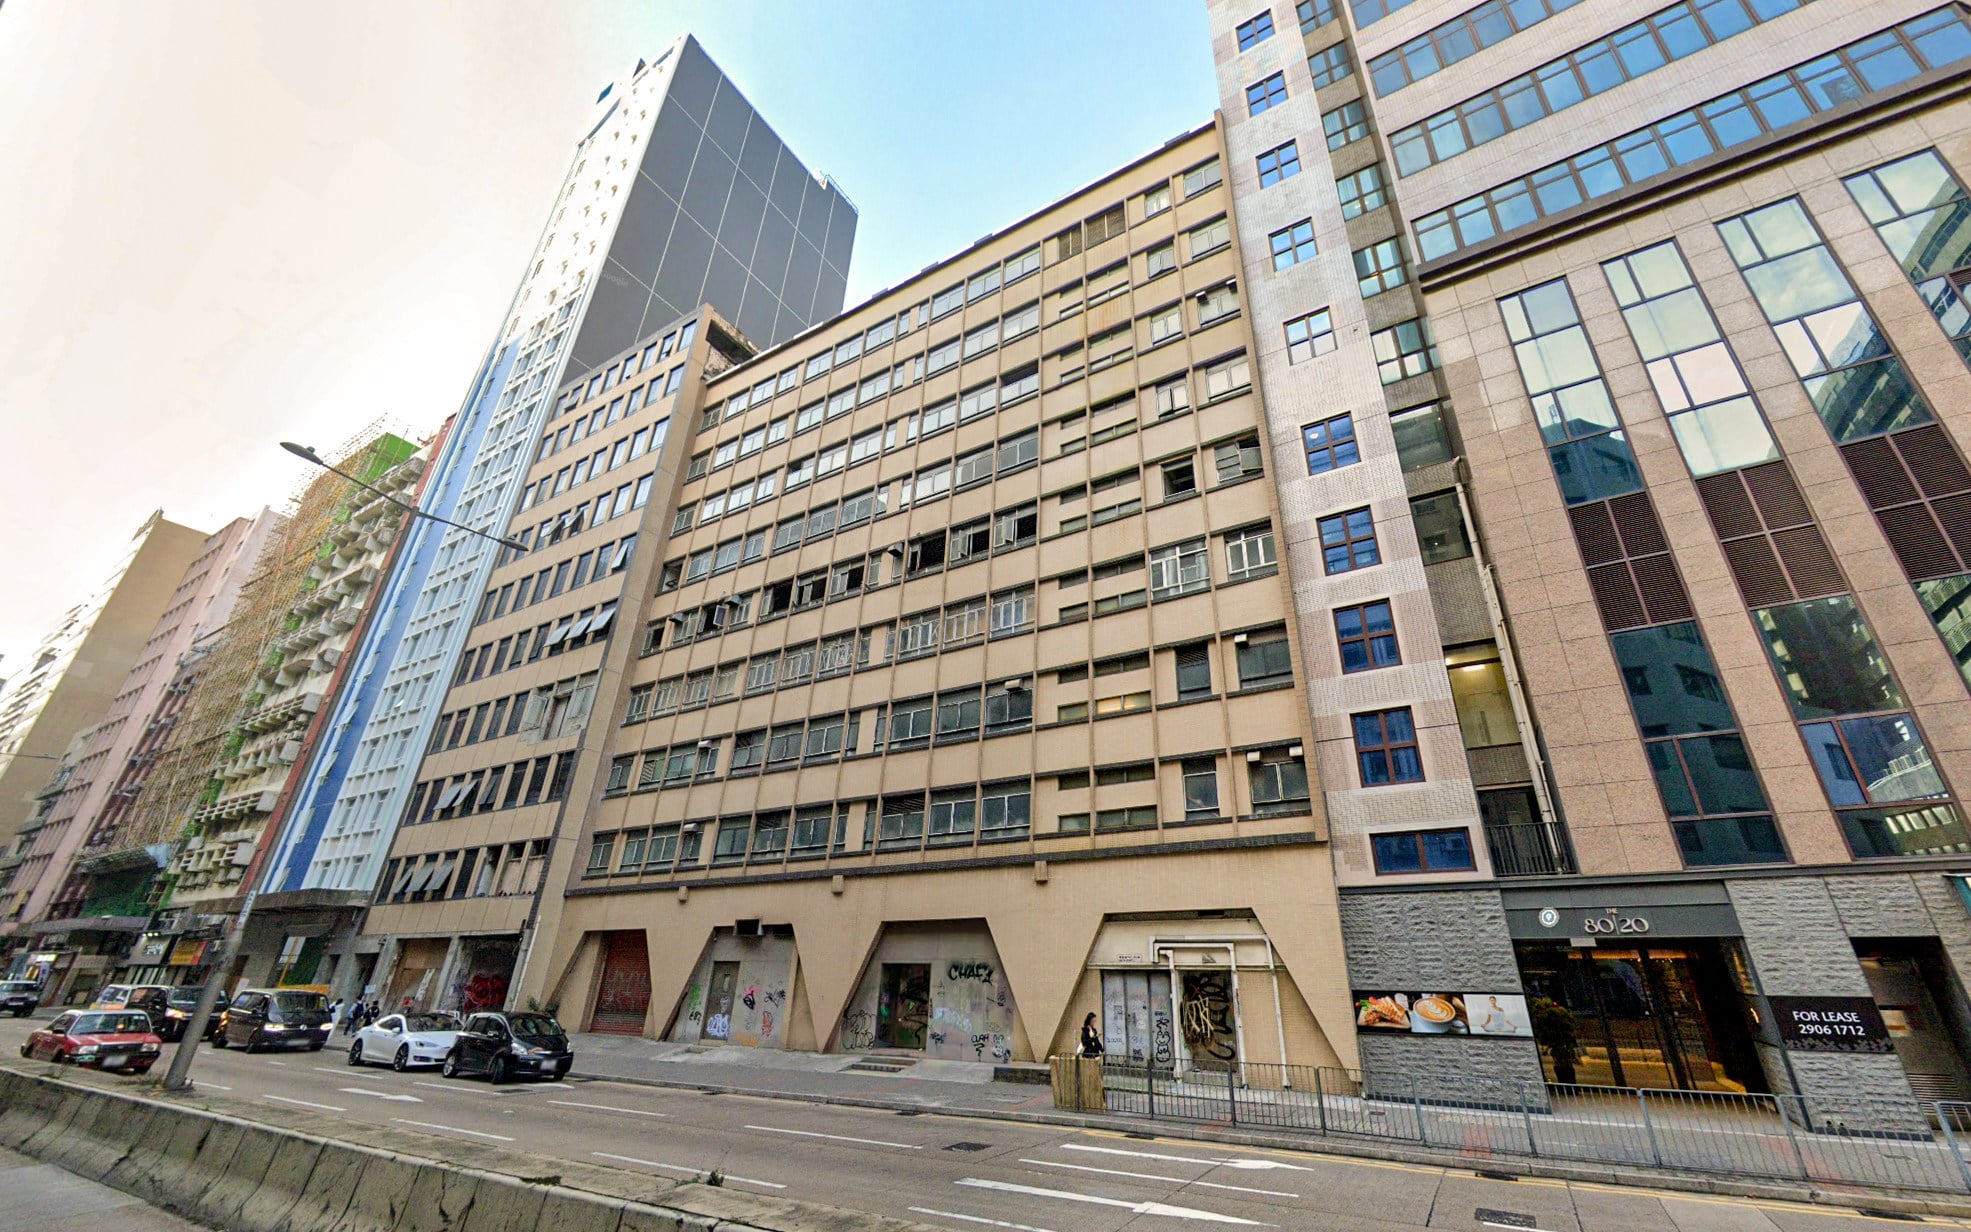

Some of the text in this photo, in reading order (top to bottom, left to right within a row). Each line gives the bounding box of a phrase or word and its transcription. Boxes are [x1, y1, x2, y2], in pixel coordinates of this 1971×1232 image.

[1792, 1011, 1861, 1023] FOR LEASE
[1798, 1024, 1866, 1036] 2906 1712
